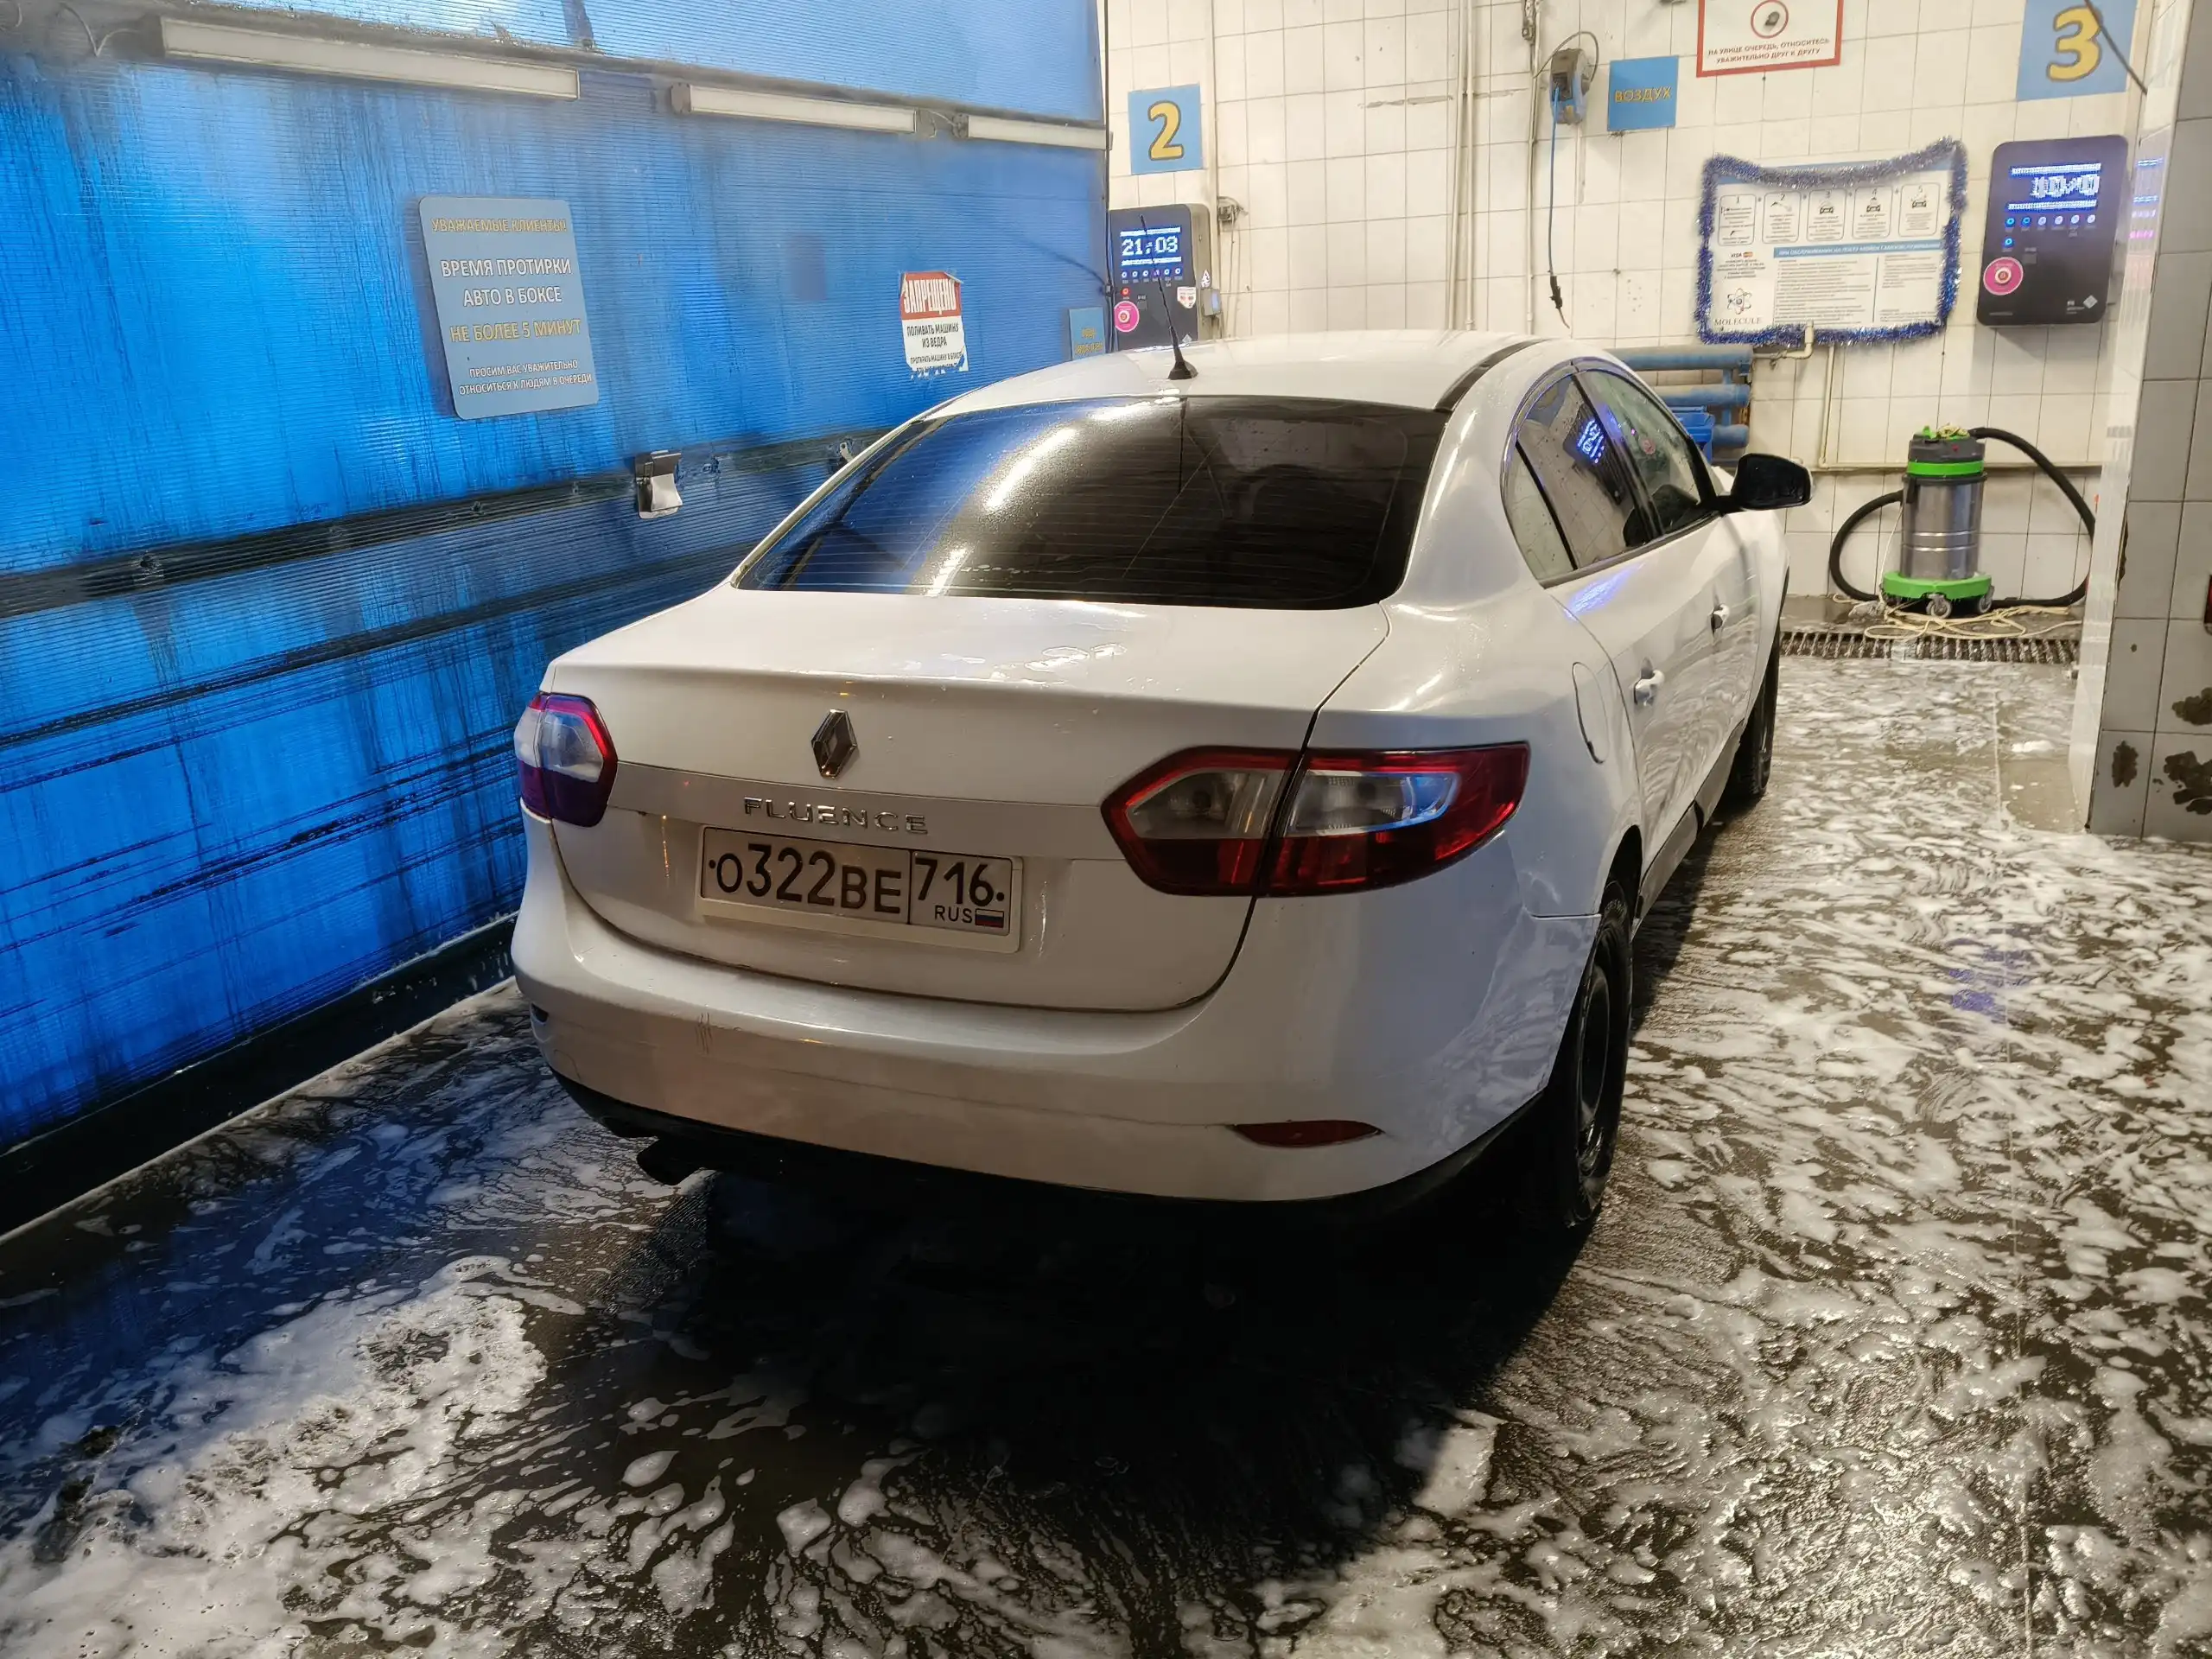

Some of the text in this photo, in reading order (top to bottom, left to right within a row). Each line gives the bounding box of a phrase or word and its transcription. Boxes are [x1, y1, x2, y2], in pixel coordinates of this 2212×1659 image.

[2046, 5, 2103, 81] 3
[1614, 86, 1671, 104] ВОЗДУХ
[1147, 100, 1185, 161] 2
[431, 219, 509, 232] УВАЖАЕМЫЕ
[441, 257, 572, 278] ВРЕМЯ ПРОТИРКИ
[463, 286, 563, 307] АВТО В БОКСЕ
[904, 278, 957, 315] ЗАПРЕЩЕНО
[450, 319, 582, 342] НЕ БОЛЕЕ 5 МИНУТ
[907, 322, 959, 336] ПОЛИВАТЬ МАШИНУ
[1714, 317, 1762, 326] MOLECULE
[922, 336, 947, 347] ИЗ ВЕДРА
[469, 359, 579, 378] ПРОСИМ ВАС УВАЖИТЕЛЬНО
[459, 382, 512, 396] ОТНОСИТЬСЯ
[520, 378, 552, 389] ЛЮДЯМ
[559, 373, 593, 385] ОЧЕРЕДИ
[743, 797, 929, 836] FLUENCE
[914, 856, 995, 907] 716
[934, 905, 973, 924] RUS
